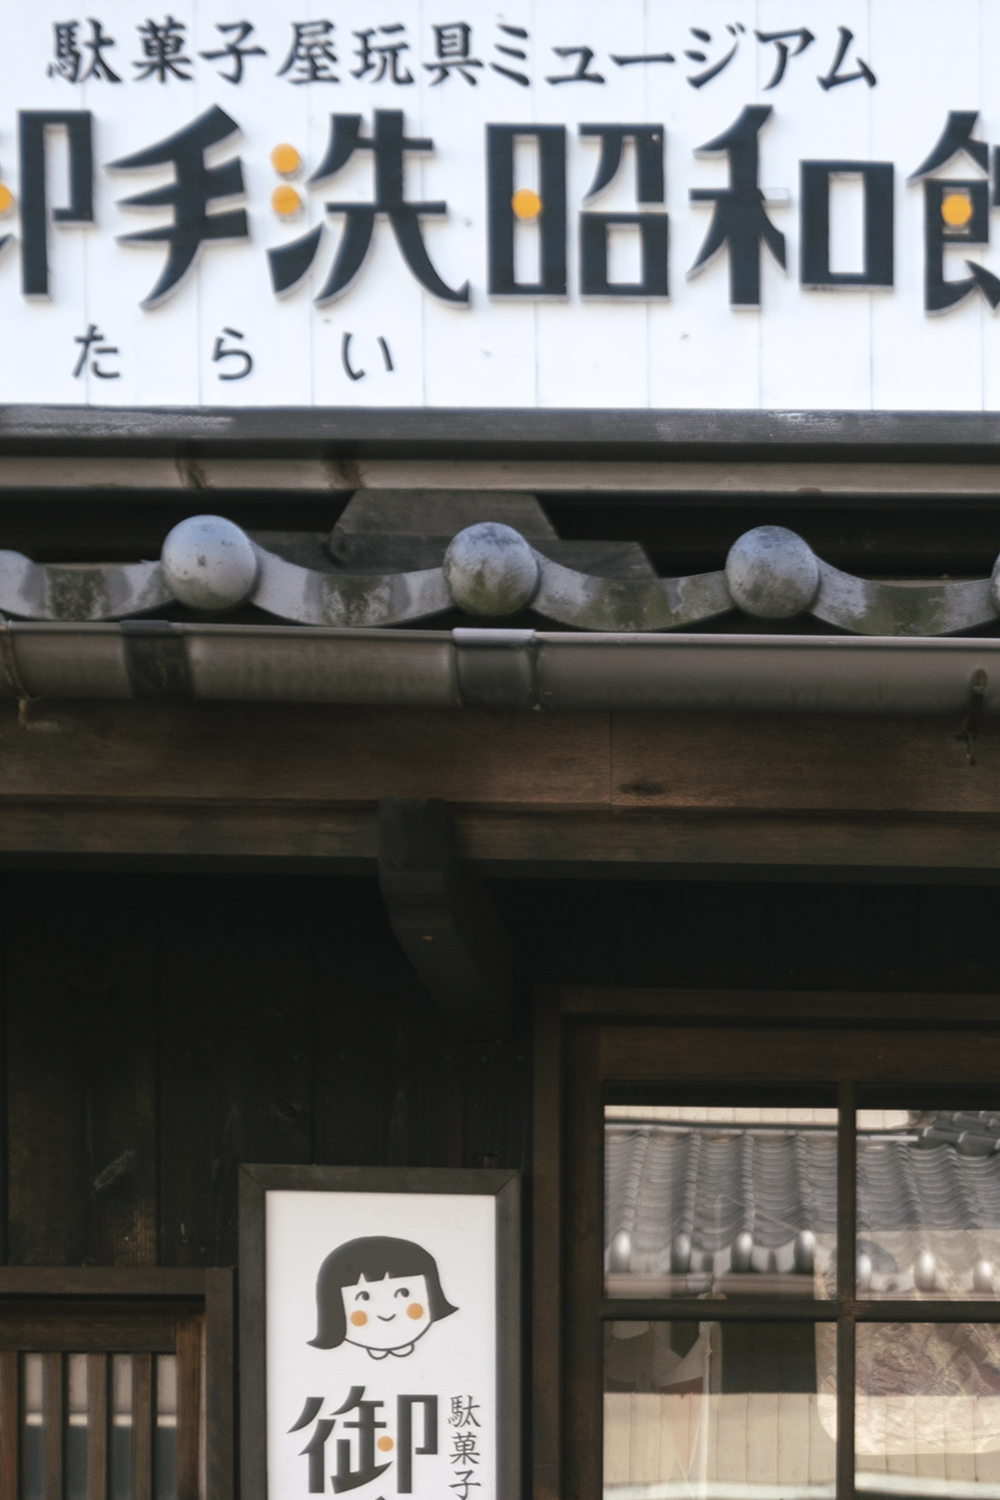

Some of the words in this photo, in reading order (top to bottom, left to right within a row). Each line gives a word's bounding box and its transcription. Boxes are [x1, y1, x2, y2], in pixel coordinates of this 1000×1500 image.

[47, 17, 877, 92] 駄菓子屋玩具ミュージアム
[72, 325, 394, 381] たらい
